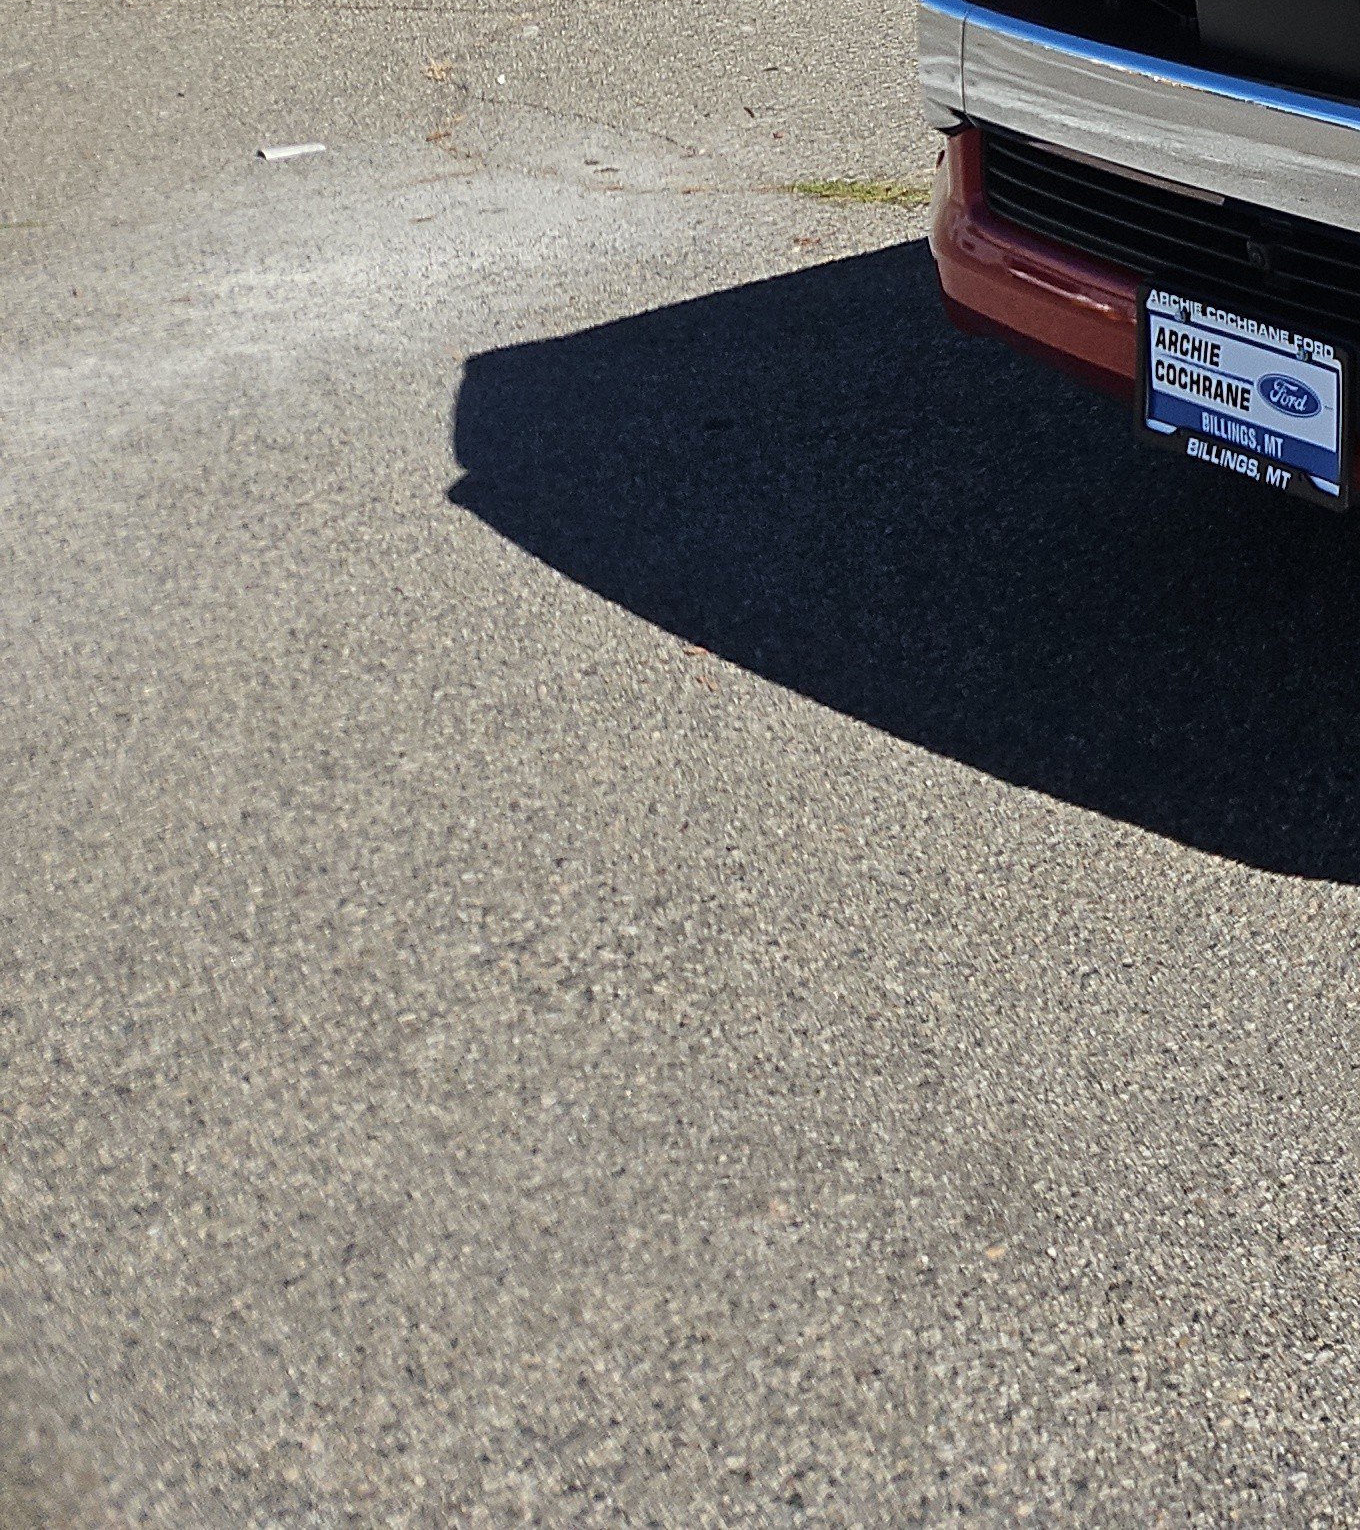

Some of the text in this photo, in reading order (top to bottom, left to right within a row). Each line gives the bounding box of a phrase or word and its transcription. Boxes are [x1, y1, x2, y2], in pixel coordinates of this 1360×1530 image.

[1149, 289, 1334, 361] ARCHIE COCHRANE FORD
[1155, 326, 1222, 368] ARCHIE
[1155, 359, 1250, 412] COCHRANE
[1269, 379, 1308, 412] Ford
[1201, 411, 1283, 459] BILLINGS, MT
[1187, 437, 1292, 490] BILLINGS, MT
